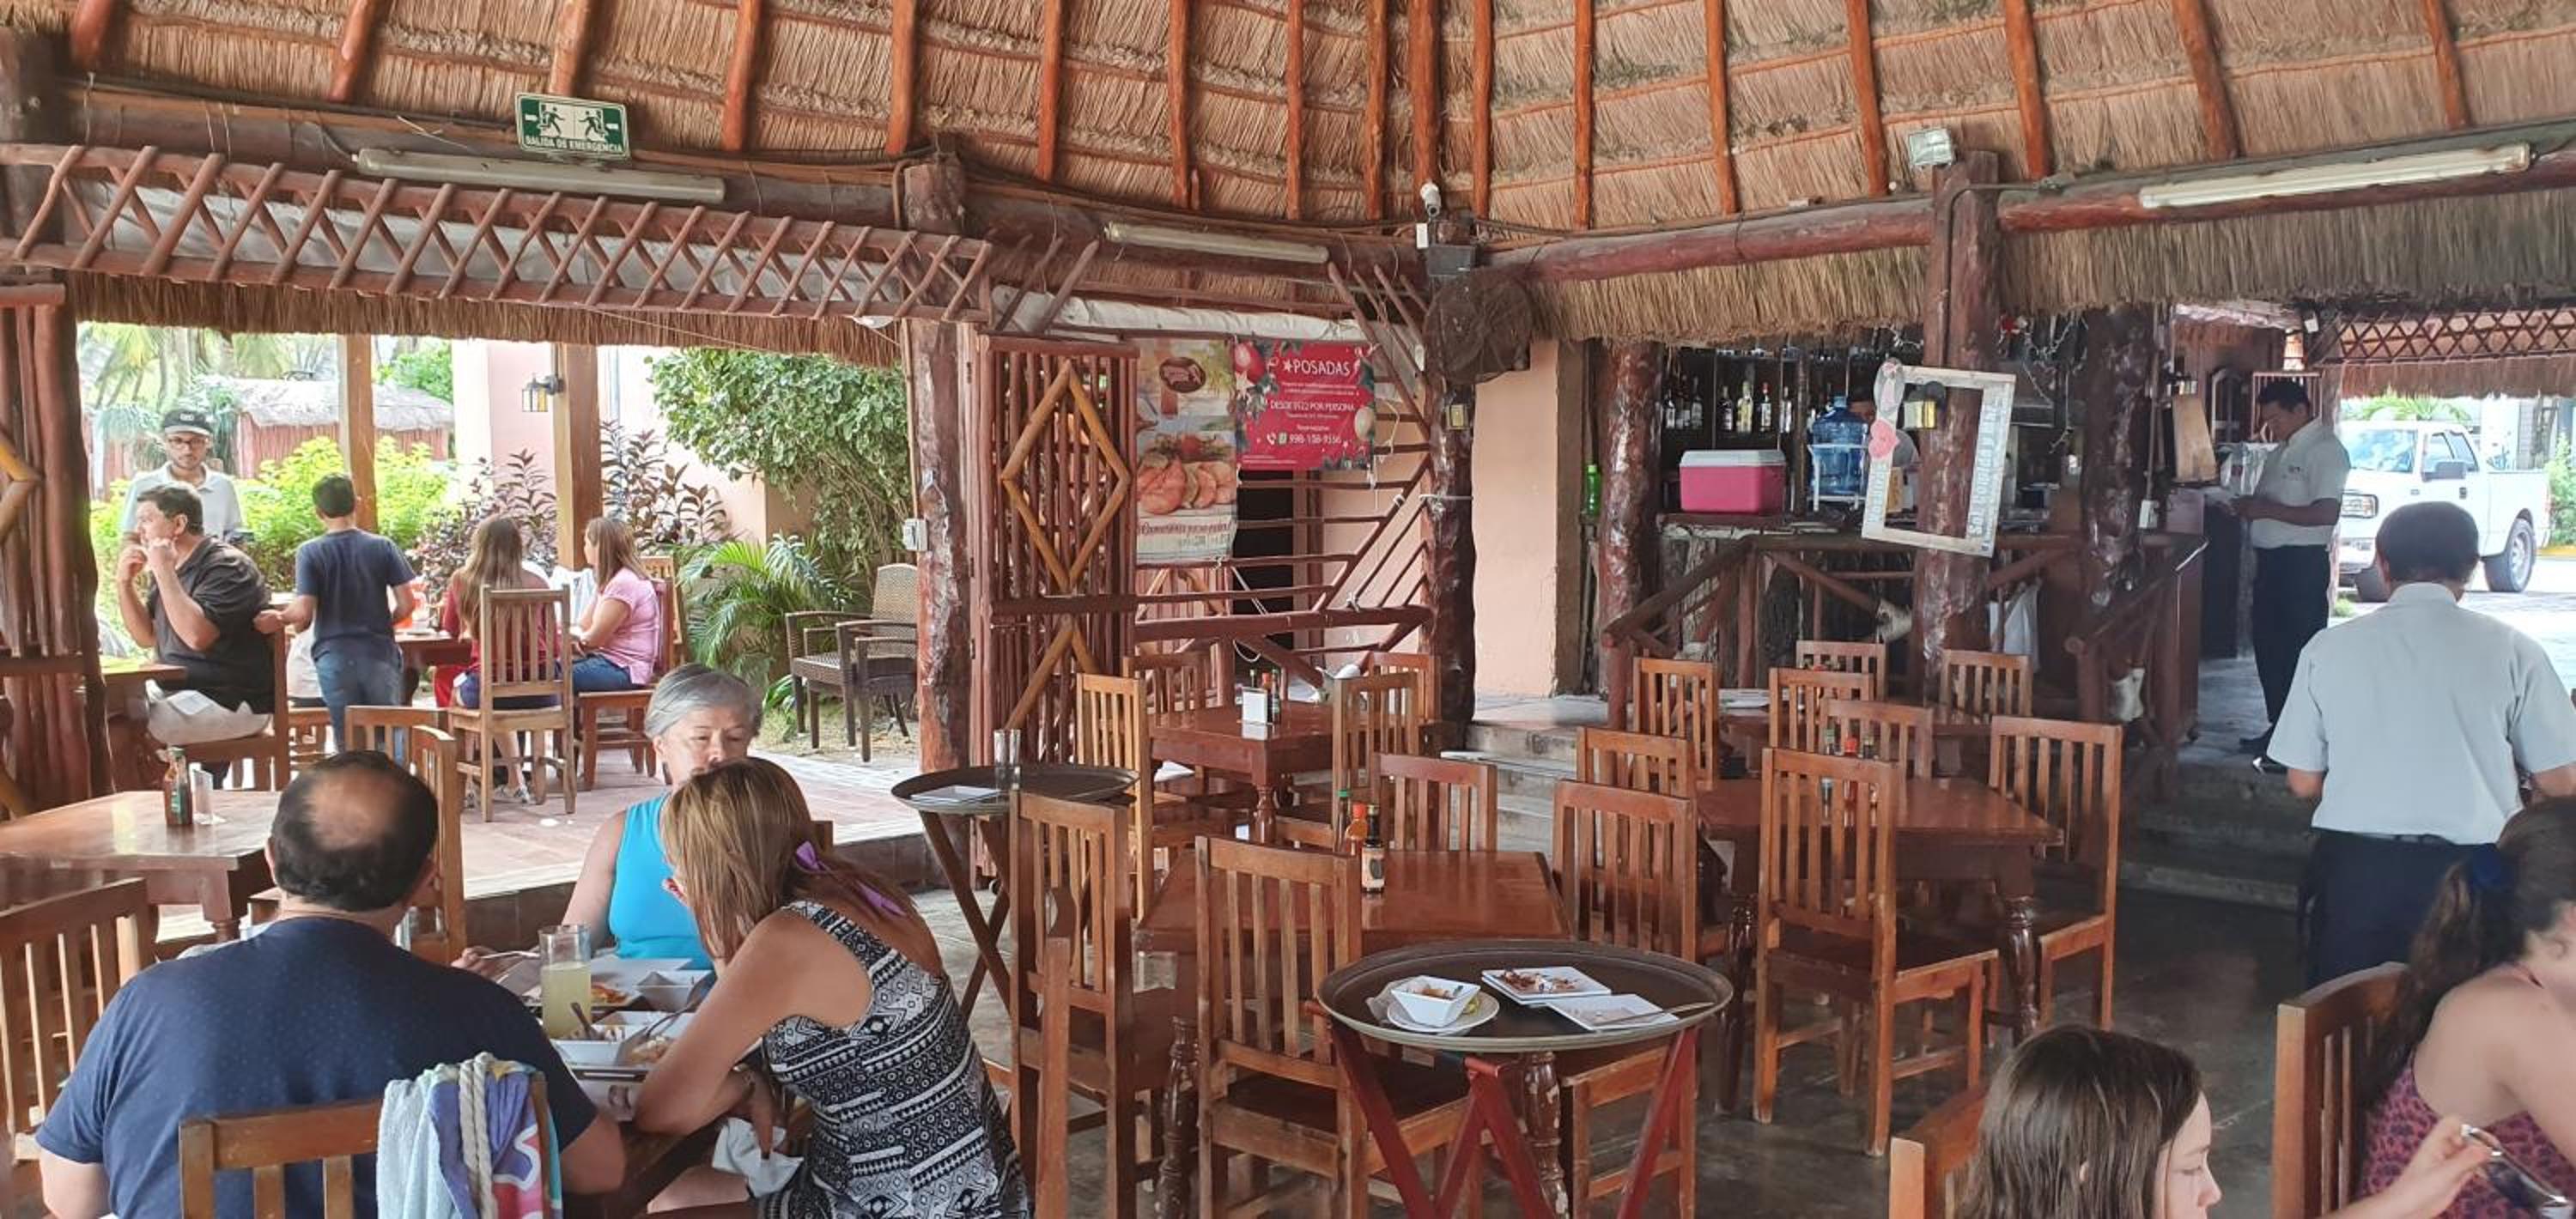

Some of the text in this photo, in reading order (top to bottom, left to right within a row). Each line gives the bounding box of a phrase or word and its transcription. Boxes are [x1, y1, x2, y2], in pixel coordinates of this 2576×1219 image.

[526, 136, 622, 152] SALIDA DE EMERGENCIA
[1293, 358, 1351, 376] POSADAS
